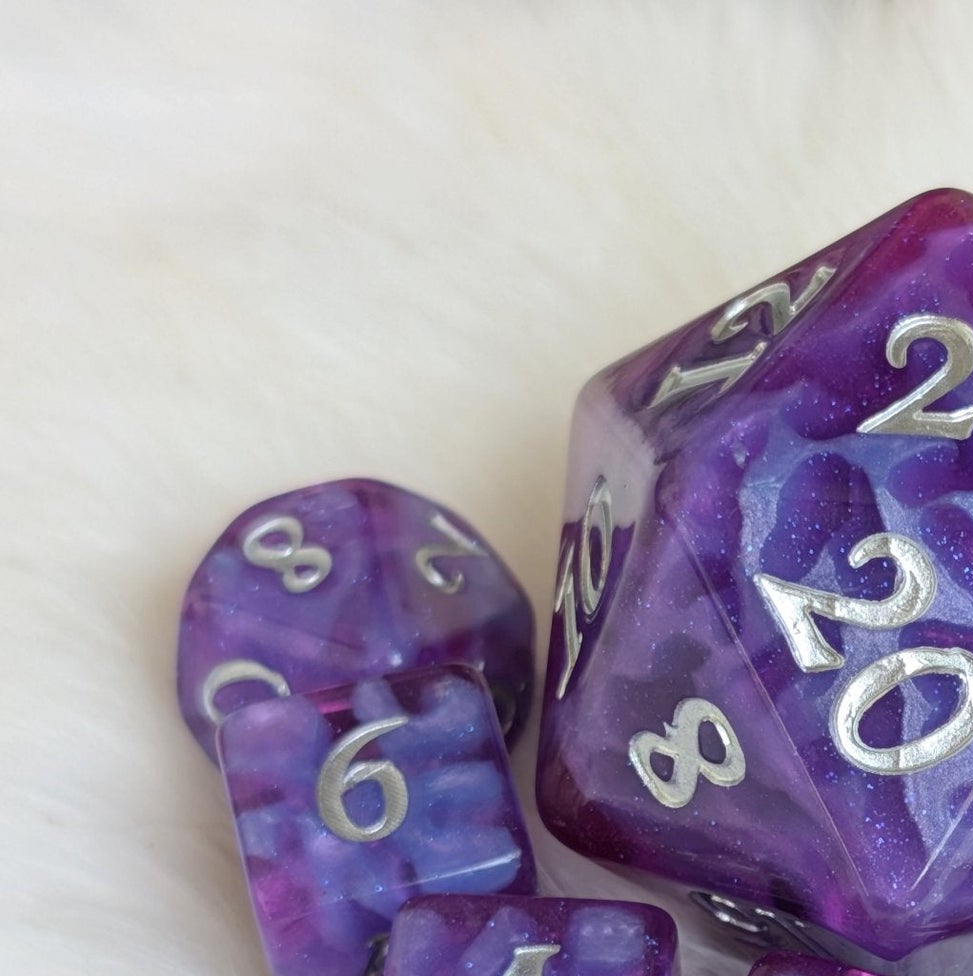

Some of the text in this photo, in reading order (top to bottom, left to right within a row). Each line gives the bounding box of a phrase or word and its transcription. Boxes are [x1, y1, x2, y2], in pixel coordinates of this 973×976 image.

[650, 266, 836, 410] 12
[243, 516, 333, 593] 8
[555, 476, 616, 700] 10
[317, 716, 408, 843] 6
[628, 696, 747, 808] 8
